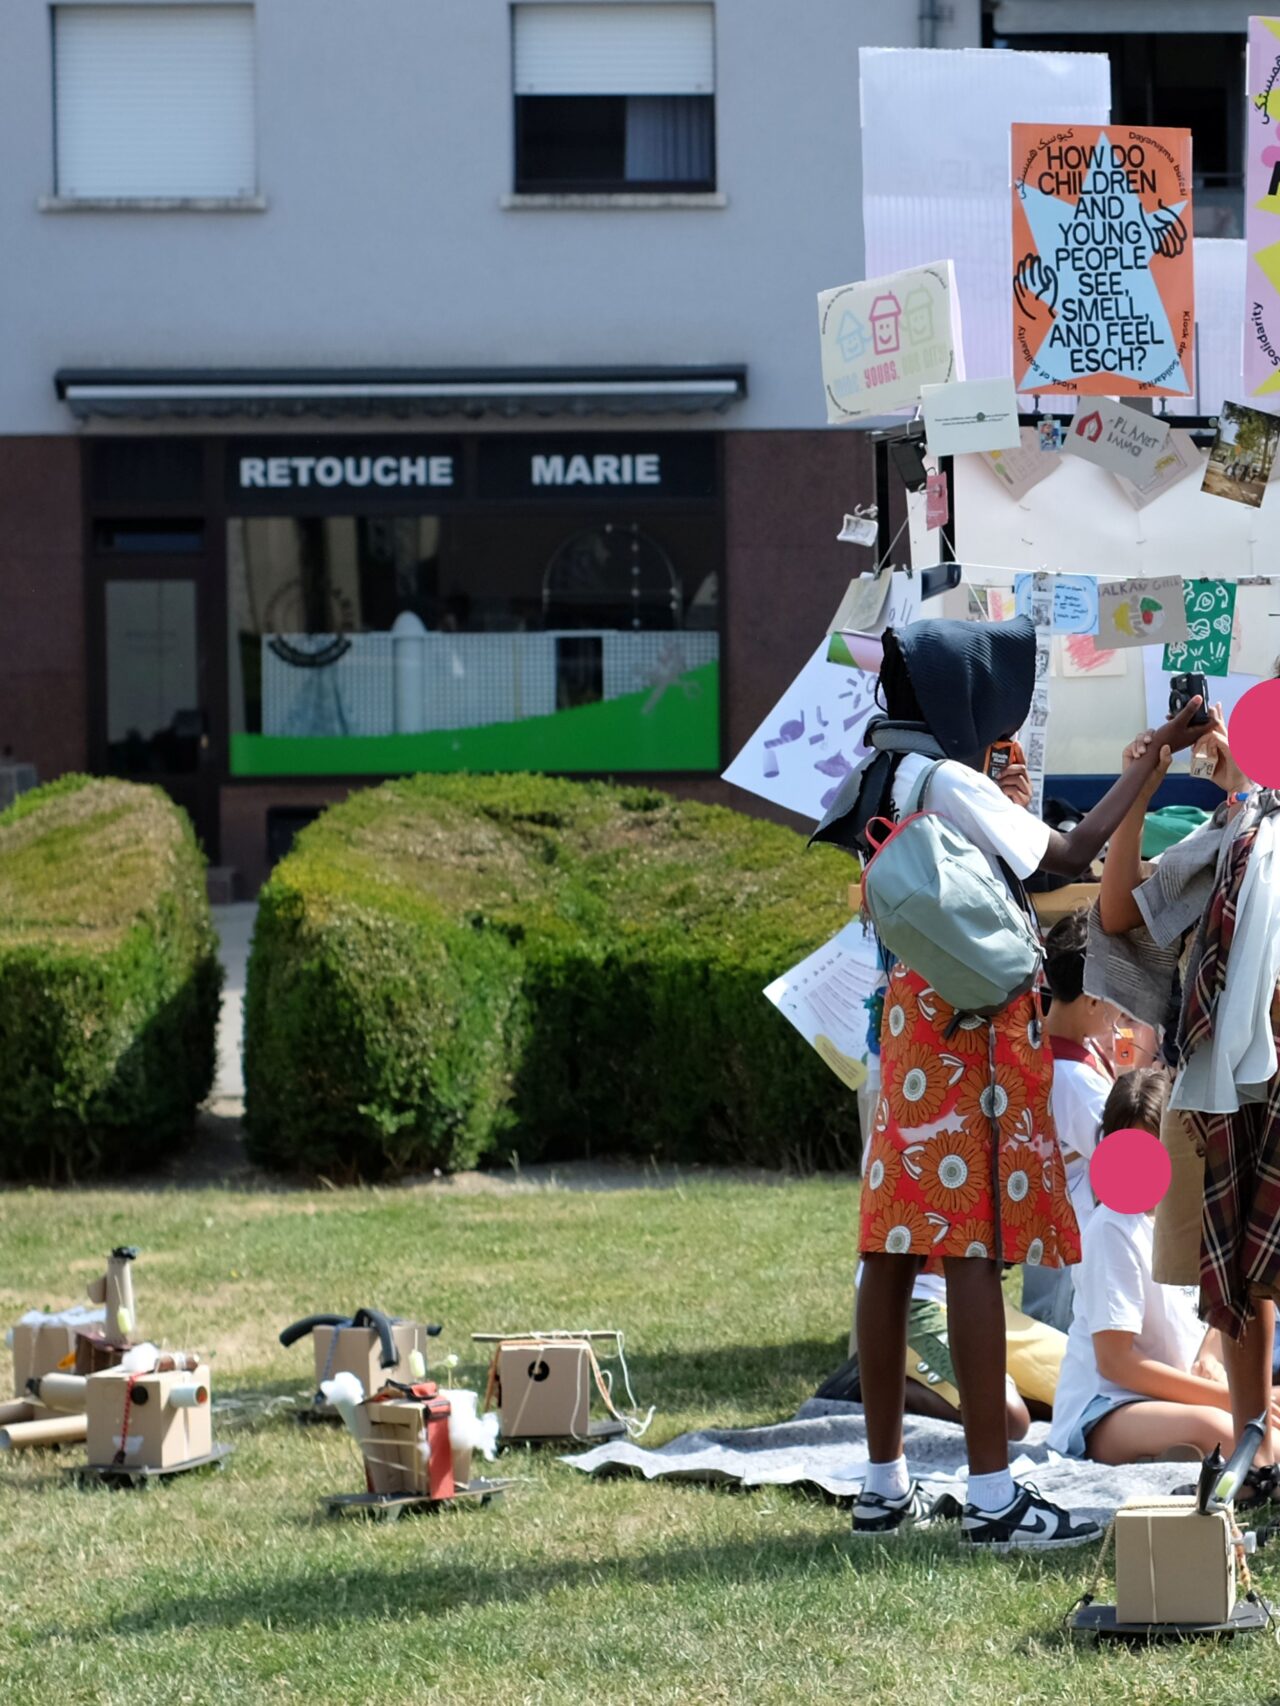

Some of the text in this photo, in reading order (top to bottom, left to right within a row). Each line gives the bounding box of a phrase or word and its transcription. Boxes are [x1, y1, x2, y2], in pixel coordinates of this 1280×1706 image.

[1046, 144, 1145, 170] HOW DO
[1038, 169, 1157, 195] CHILDREN
[1074, 196, 1125, 220] AND
[1058, 221, 1142, 245] YOUNG
[1055, 245, 1147, 272] PEOPLE
[1078, 272, 1129, 297] SEE,
[1061, 296, 1149, 322] SMELL,
[1049, 321, 1164, 348] AND FEEL
[1070, 346, 1147, 373] ESCH?
[239, 454, 660, 487] RETOUCHE MARIE
